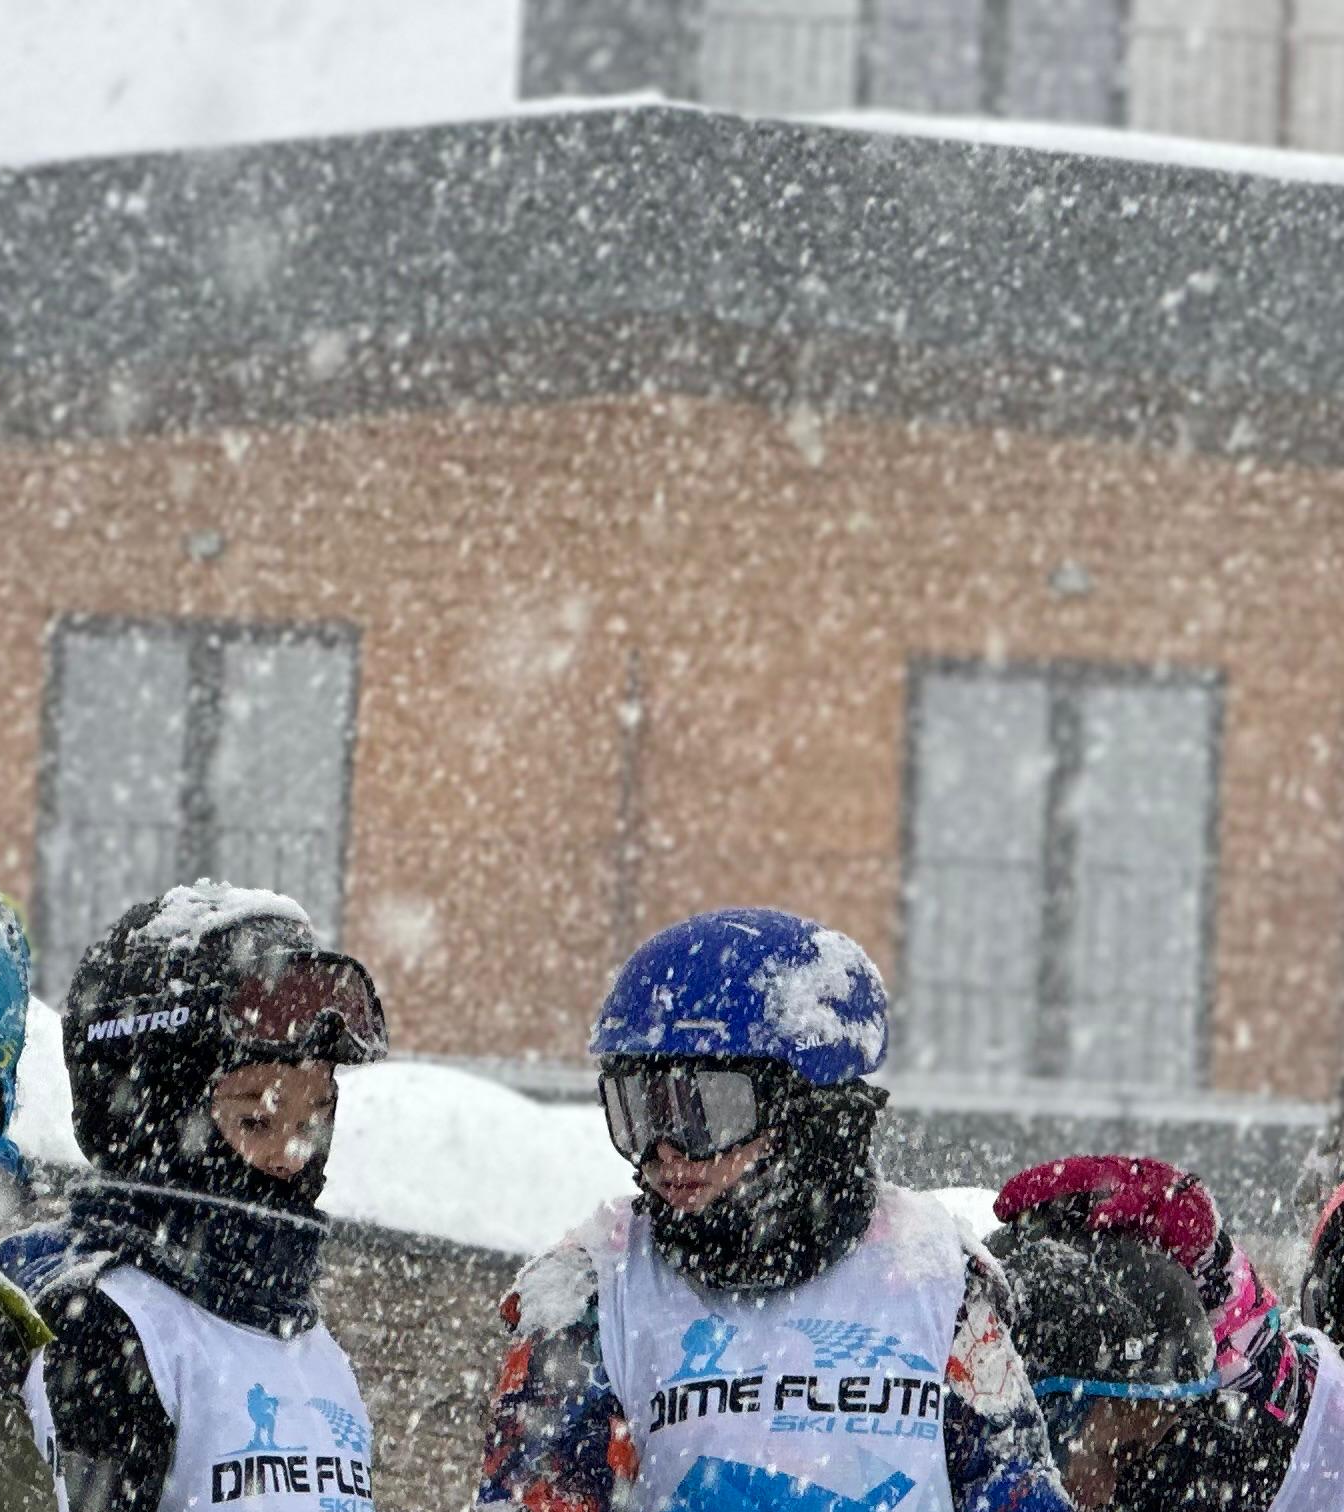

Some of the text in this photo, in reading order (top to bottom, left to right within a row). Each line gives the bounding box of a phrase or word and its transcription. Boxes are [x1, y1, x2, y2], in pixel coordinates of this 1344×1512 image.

[87, 1007, 190, 1042] WINTRO
[769, 1414, 939, 1441] SKI CLUB
[211, 1454, 373, 1504] DIME FLE
